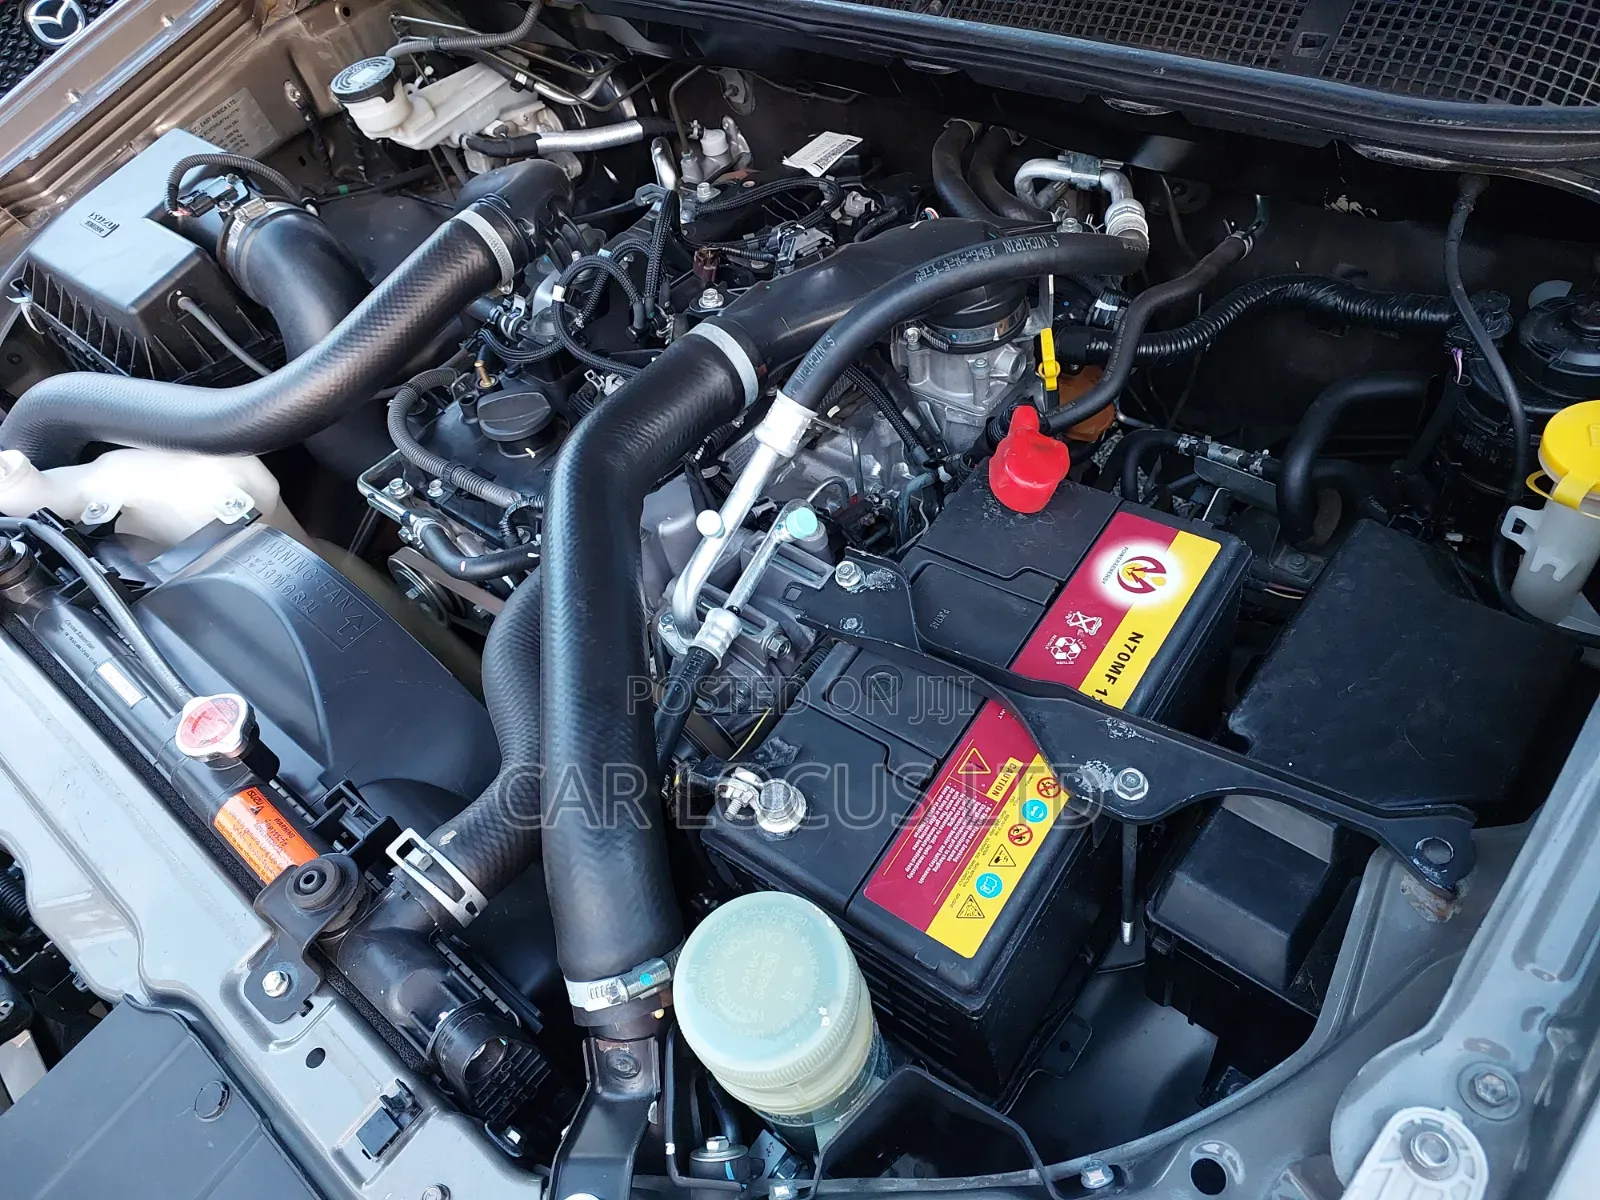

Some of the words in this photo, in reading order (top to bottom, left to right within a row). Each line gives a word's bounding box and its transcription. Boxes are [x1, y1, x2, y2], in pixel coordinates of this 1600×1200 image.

[212, 106, 227, 119] AFRICA
[1105, 632, 1144, 685] N70MF
[992, 762, 1017, 796] CAUTION
[246, 790, 264, 806] ISUZU
[951, 790, 960, 800] with
[953, 797, 962, 806] case
[937, 799, 947, 810] block
[928, 814, 937, 824] alter
[938, 810, 947, 820] Then
[946, 809, 961, 827] charging
[274, 818, 295, 838] WARNING
[912, 820, 927, 838] children
[951, 816, 964, 830] vehicle
[918, 824, 931, 839] venting
[920, 826, 937, 847] immediate
[952, 824, 965, 840] vehicle
[911, 838, 922, 850] holes
[945, 838, 956, 850] prior
[953, 829, 969, 850] ventilated
[910, 846, 924, 862] medical
[937, 844, 946, 853] and
[945, 849, 956, 862] areas
[952, 843, 967, 862] Smoking
[903, 861, 913, 872] help
[905, 854, 926, 879] immediately
[927, 851, 941, 867] battery
[931, 853, 946, 872] charging
[917, 866, 932, 884] manuals
[741, 906, 766, 918] TYPE
[752, 914, 778, 926] ONLY
[784, 922, 800, 935] USE
[721, 930, 783, 960] CAUTION
